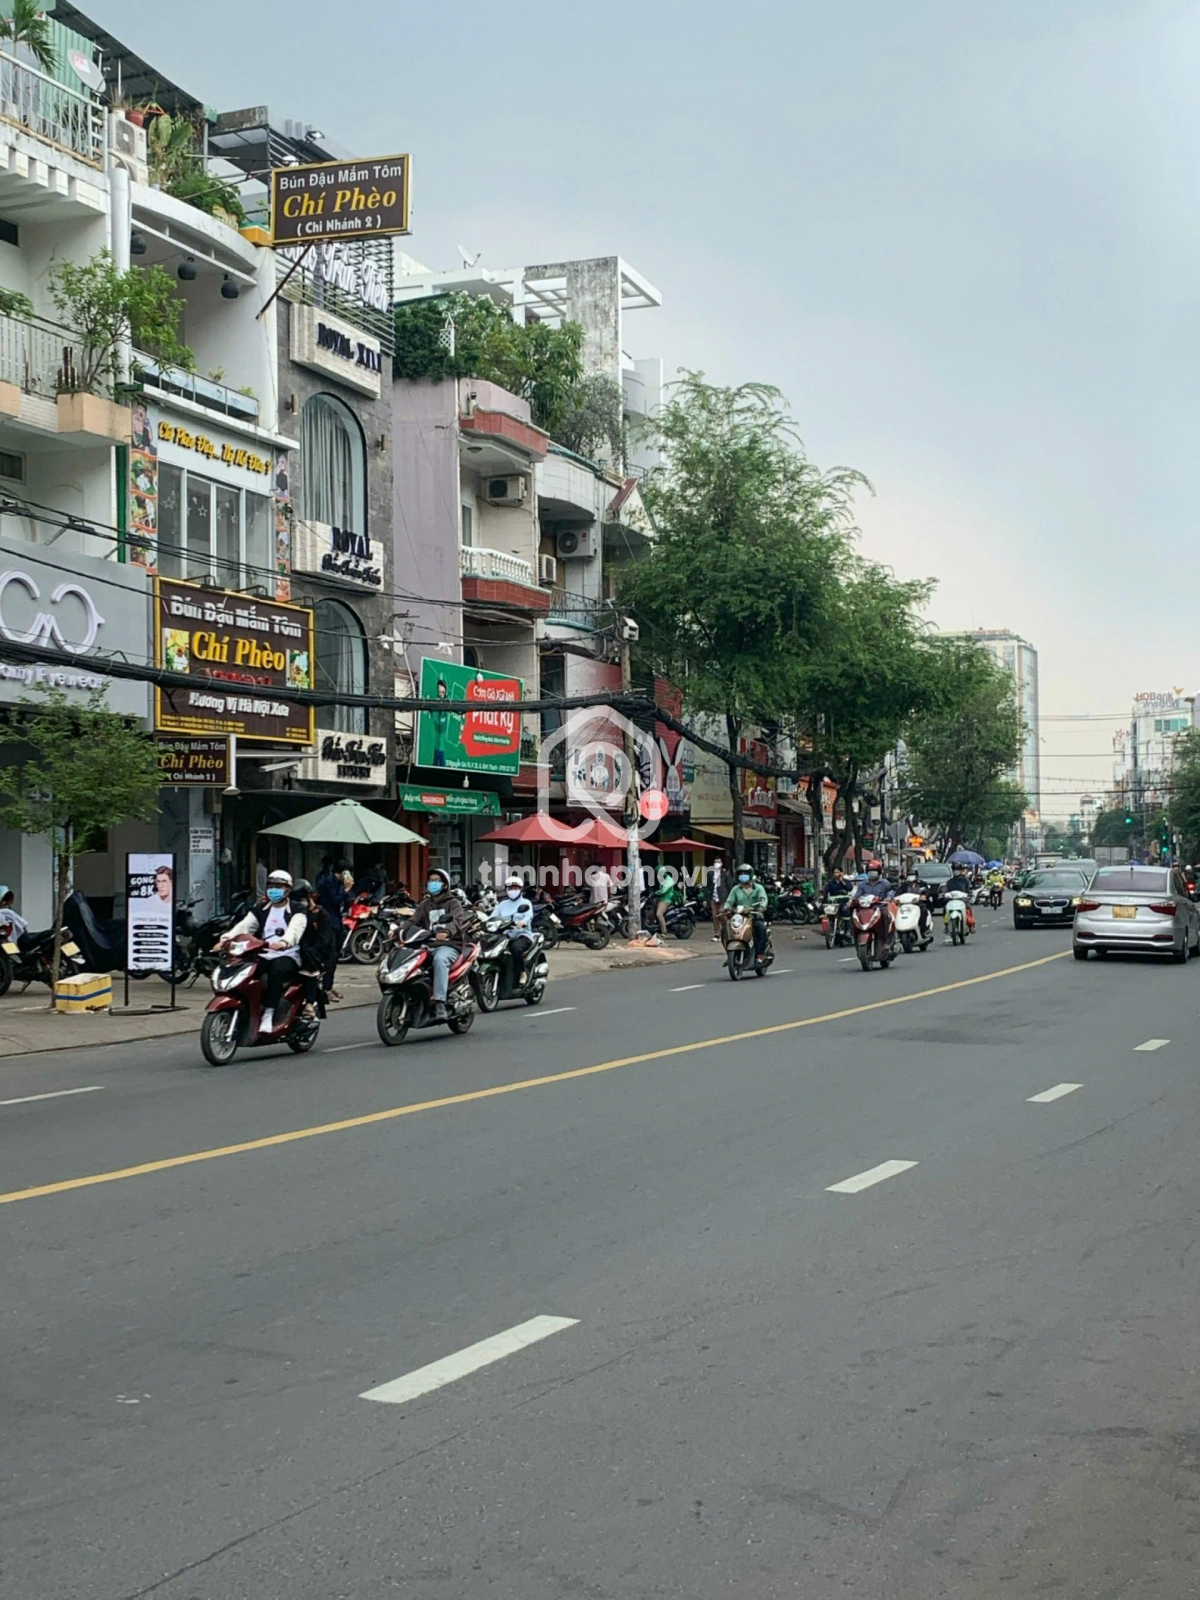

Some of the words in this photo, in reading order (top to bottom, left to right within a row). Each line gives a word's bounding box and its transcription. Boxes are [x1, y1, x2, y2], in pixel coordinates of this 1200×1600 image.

[280, 175, 305, 190] Bún
[309, 172, 334, 188] Đậu
[338, 165, 369, 183] Mắm
[373, 164, 402, 178] Tôm
[283, 192, 326, 218] Chí
[332, 186, 397, 213] Phèo
[316, 322, 355, 359] ROYAL
[332, 526, 373, 560] ROYAL
[170, 595, 202, 620] Bún
[204, 601, 234, 628] Đậu
[236, 606, 270, 632] Mắm
[271, 615, 302, 638] Tôm
[192, 631, 230, 663] Chí
[234, 638, 285, 671] Phèo
[238, 698, 253, 713] Hà
[1136, 692, 1174, 701] HDBank
[210, 740, 226, 750] Tôm
[188, 754, 224, 770] Phèo
[140, 885, 154, 896] 8K
